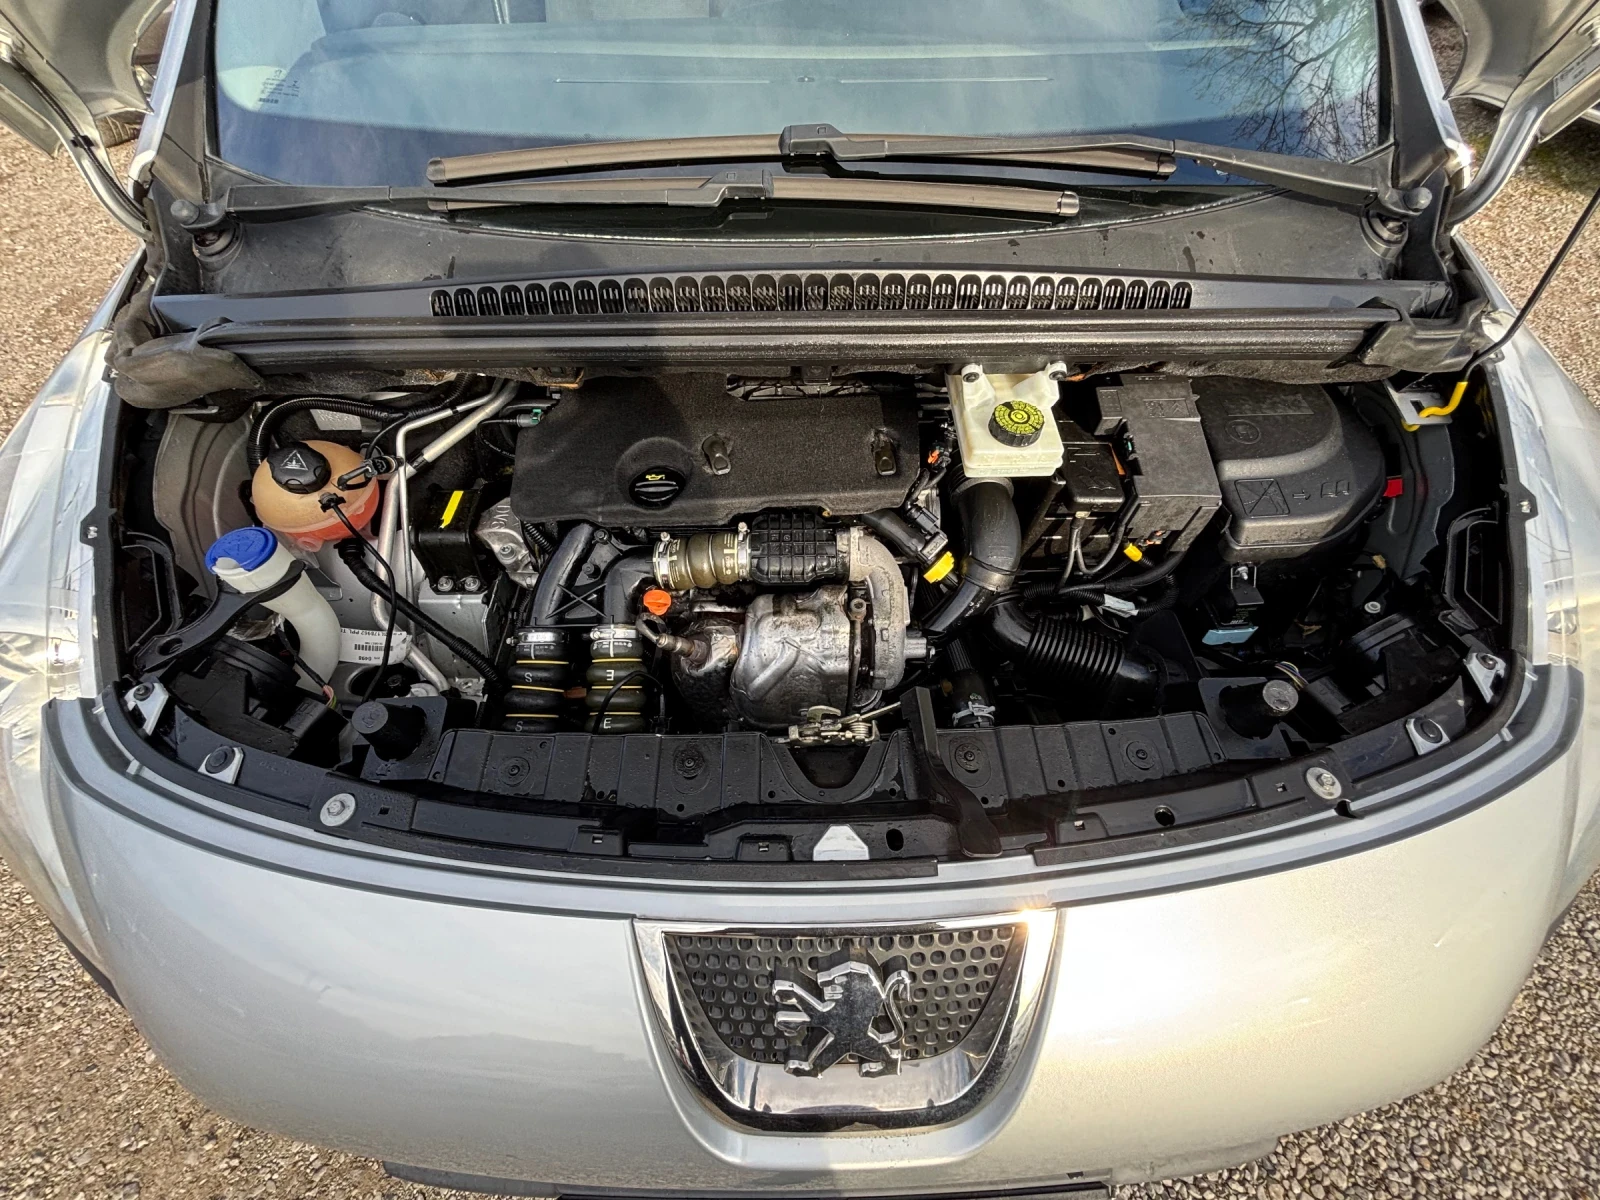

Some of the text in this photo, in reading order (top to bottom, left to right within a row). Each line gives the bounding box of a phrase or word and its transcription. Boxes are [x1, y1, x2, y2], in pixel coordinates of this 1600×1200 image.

[524, 672, 532, 683] S
[515, 720, 523, 732] S
[603, 717, 612, 729] E
